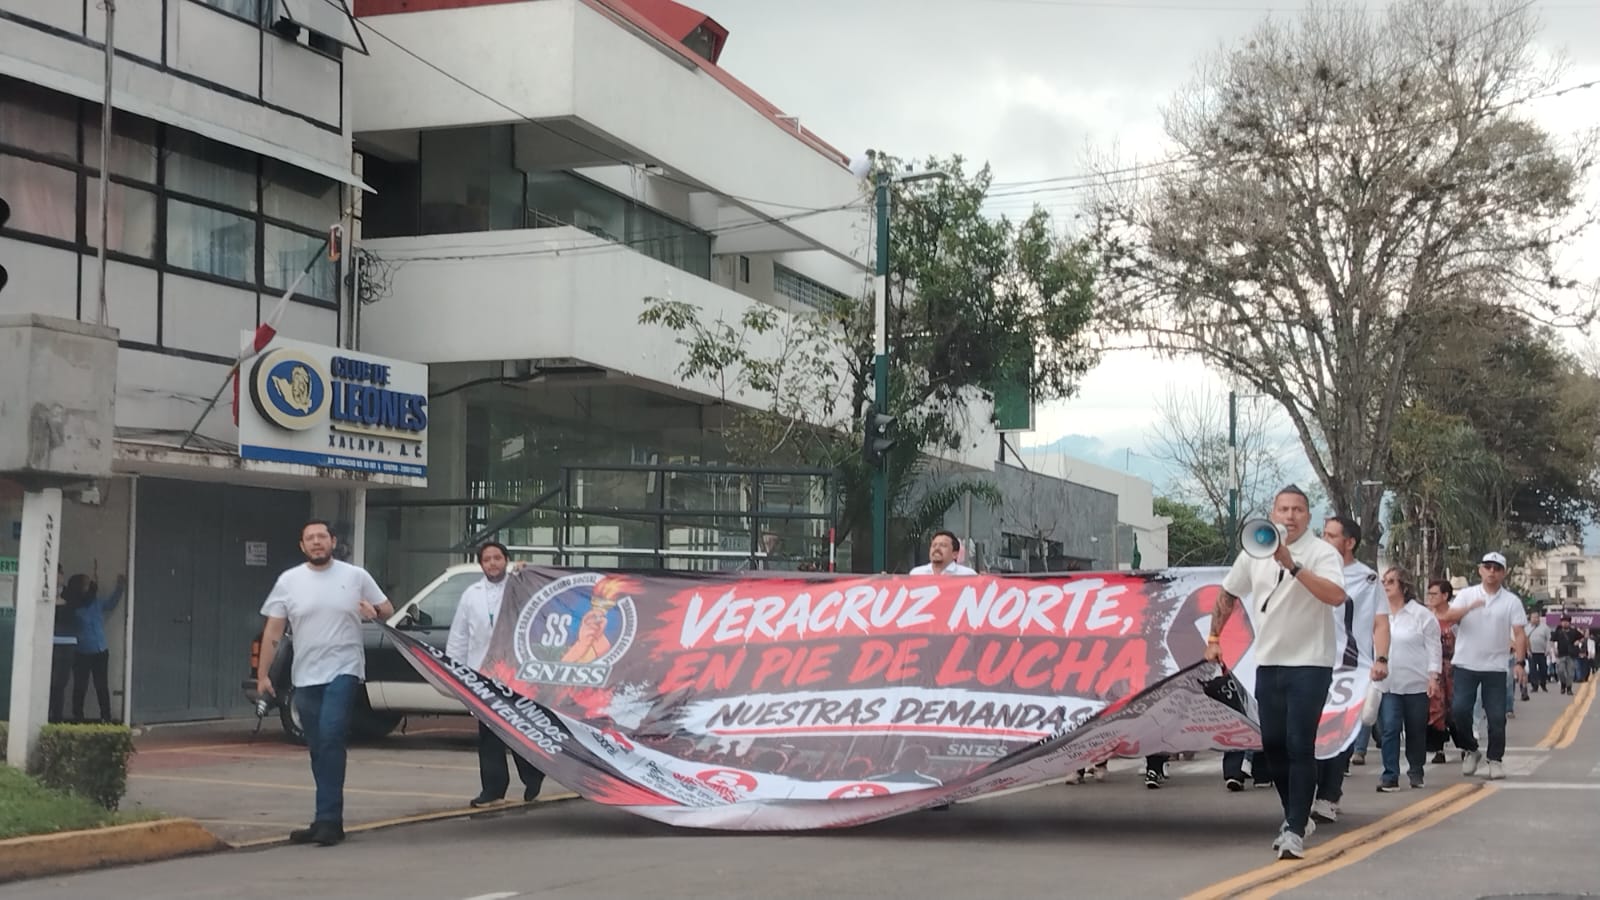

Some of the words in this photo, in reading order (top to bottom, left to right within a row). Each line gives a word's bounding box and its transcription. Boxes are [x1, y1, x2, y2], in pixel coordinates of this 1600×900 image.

[331, 356, 371, 381] CLUB
[370, 363, 391, 385] DE
[330, 381, 427, 432] LEONES
[541, 612, 573, 647] SS
[680, 584, 941, 649] VERACRUZ
[947, 578, 1134, 636] NORTE,
[522, 663, 606, 684] SNTSS
[658, 649, 747, 695] EN
[751, 643, 840, 690] PIE
[848, 637, 928, 684] DE
[935, 635, 1149, 699] LUCHA
[491, 700, 562, 755] VENCIDOS
[515, 696, 569, 742] UNIDOS
[706, 698, 886, 729] NUESTRAS
[891, 698, 1093, 730] DEMANDAS
[946, 743, 1008, 757] SNTSS
